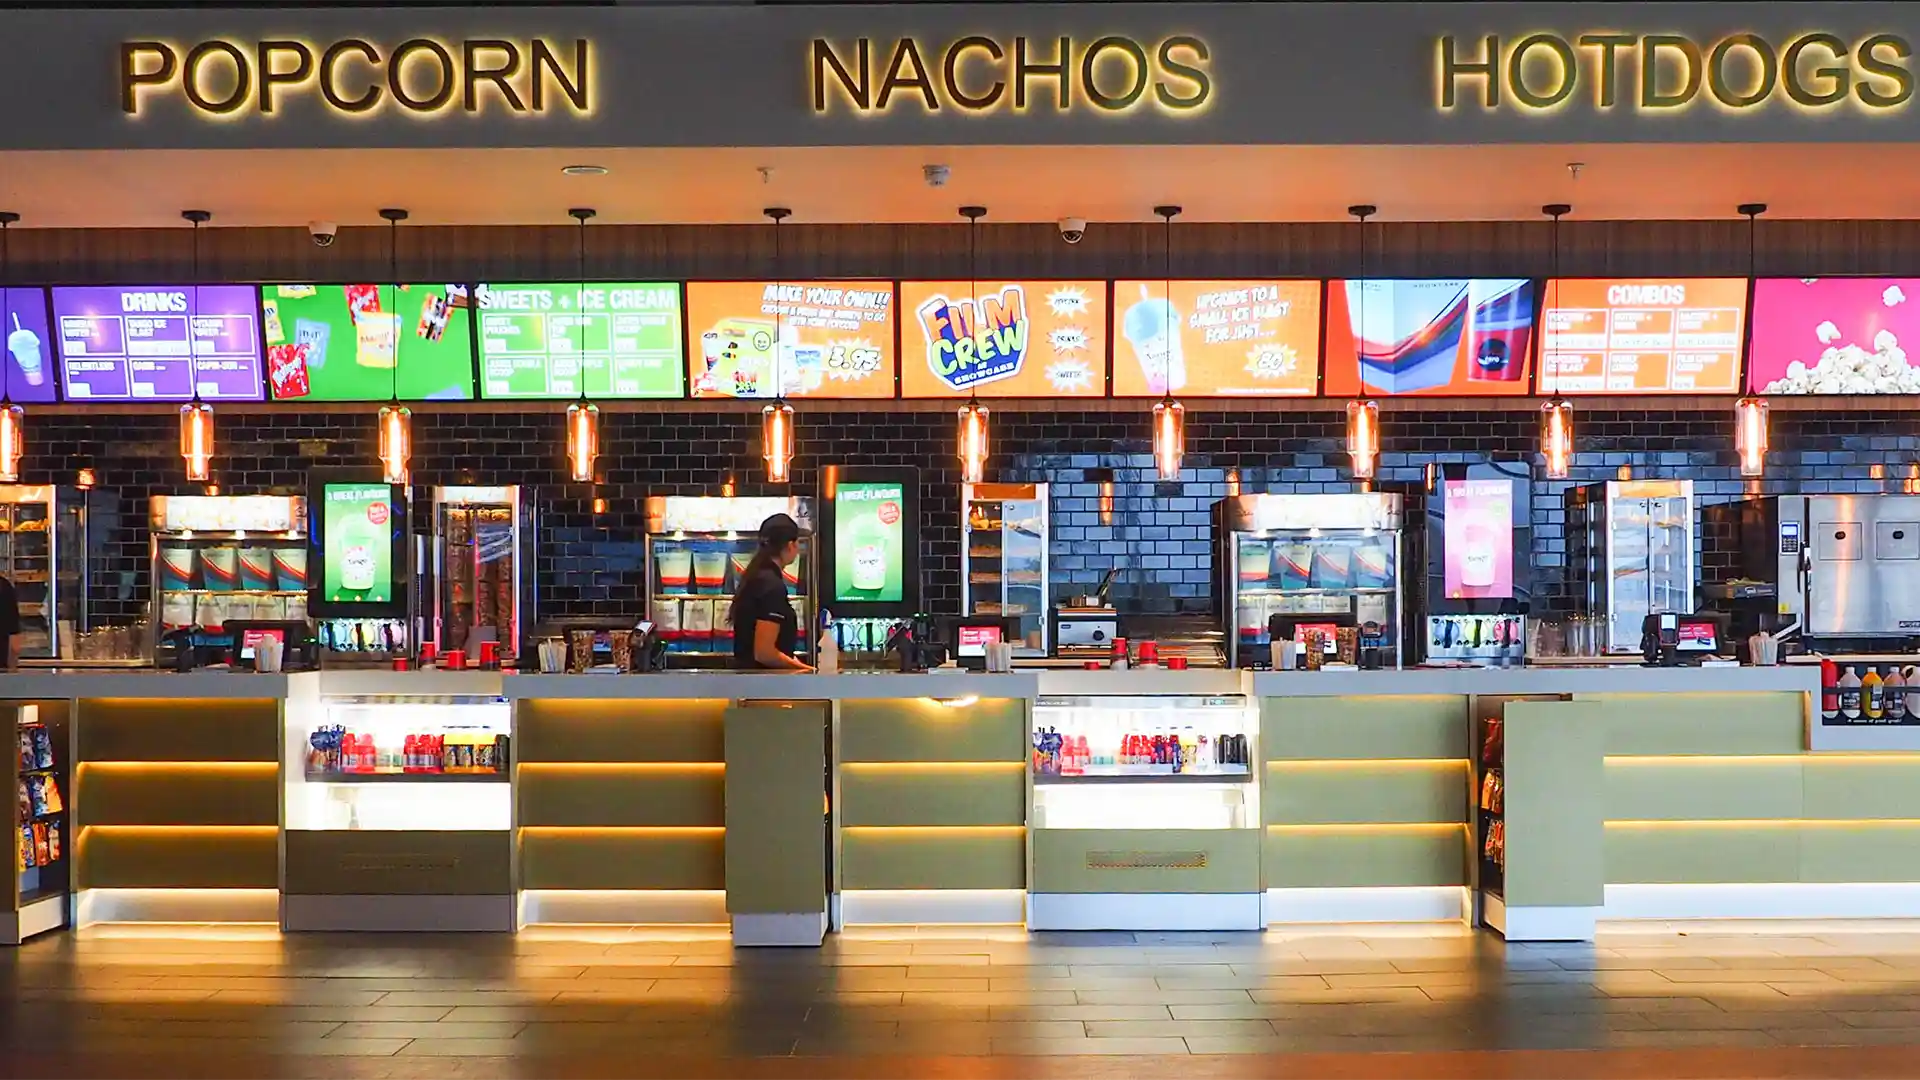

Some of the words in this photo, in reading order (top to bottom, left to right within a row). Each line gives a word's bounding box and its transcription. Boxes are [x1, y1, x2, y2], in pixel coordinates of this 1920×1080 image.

[121, 38, 588, 114] POPCORN
[812, 36, 1210, 112] NACHOS
[1441, 33, 1915, 108] HOTDOGS
[121, 292, 188, 312] DRINKS
[479, 289, 552, 310] SWEETS
[577, 289, 605, 309] ICE
[609, 289, 676, 310] CREAM
[762, 285, 803, 302] MAKE
[805, 287, 843, 306] YOUR
[843, 289, 891, 310] OWN!!
[1196, 289, 1249, 309] UPGRADE
[1251, 286, 1267, 302] TO
[1268, 285, 1278, 300] A
[1608, 285, 1685, 305] COMBOS
[919, 289, 1023, 342] FILM
[1189, 310, 1229, 328] SMALL
[1231, 307, 1250, 321] ICE
[1252, 301, 1290, 321] BLAST
[931, 319, 1025, 376] CREW
[1206, 327, 1230, 344] FOR
[954, 362, 1015, 385] SHOWCASE
